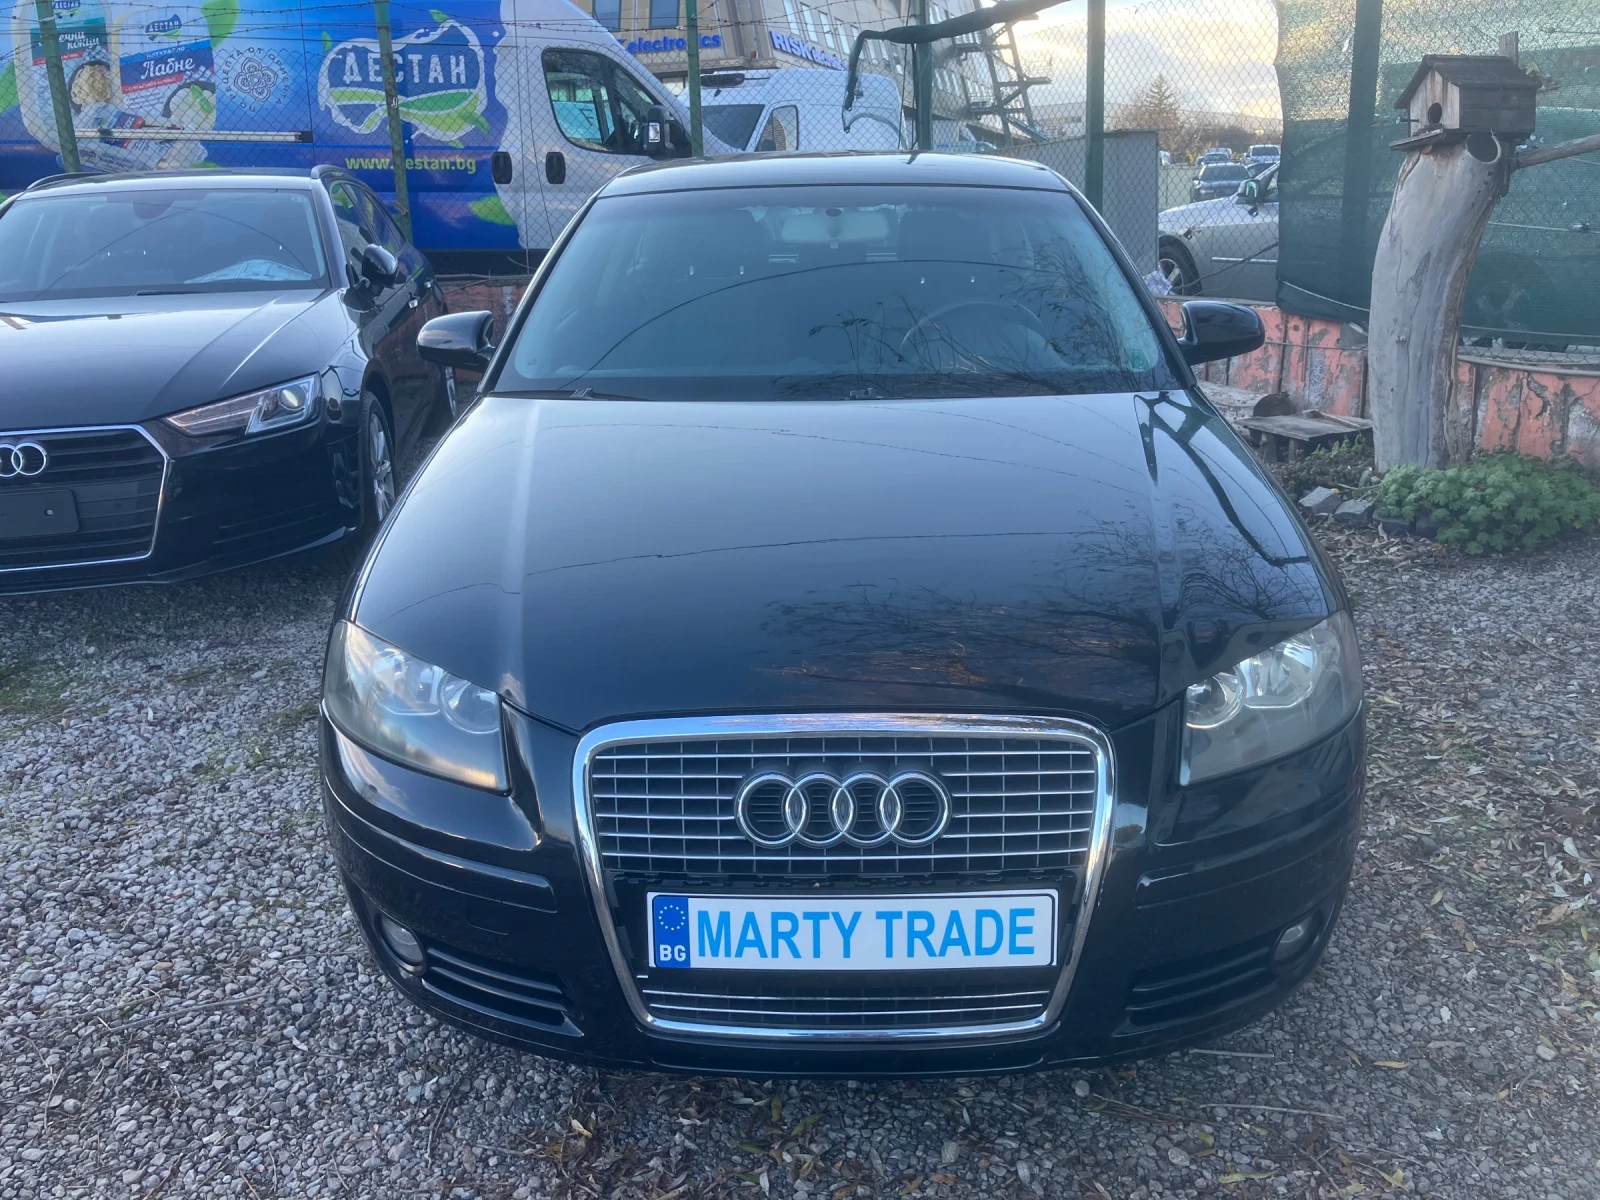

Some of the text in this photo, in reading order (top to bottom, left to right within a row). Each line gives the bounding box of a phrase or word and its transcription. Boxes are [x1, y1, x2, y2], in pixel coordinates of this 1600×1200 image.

[148, 20, 179, 32] ДЕСТАН
[247, 46, 264, 54] ОТ
[626, 34, 721, 54] electroics
[769, 30, 813, 61] RISK
[140, 57, 196, 80] Лабне
[345, 154, 477, 174] www.estan.bg
[697, 907, 1036, 959] MARTY TRADE
[659, 944, 687, 963] BG
